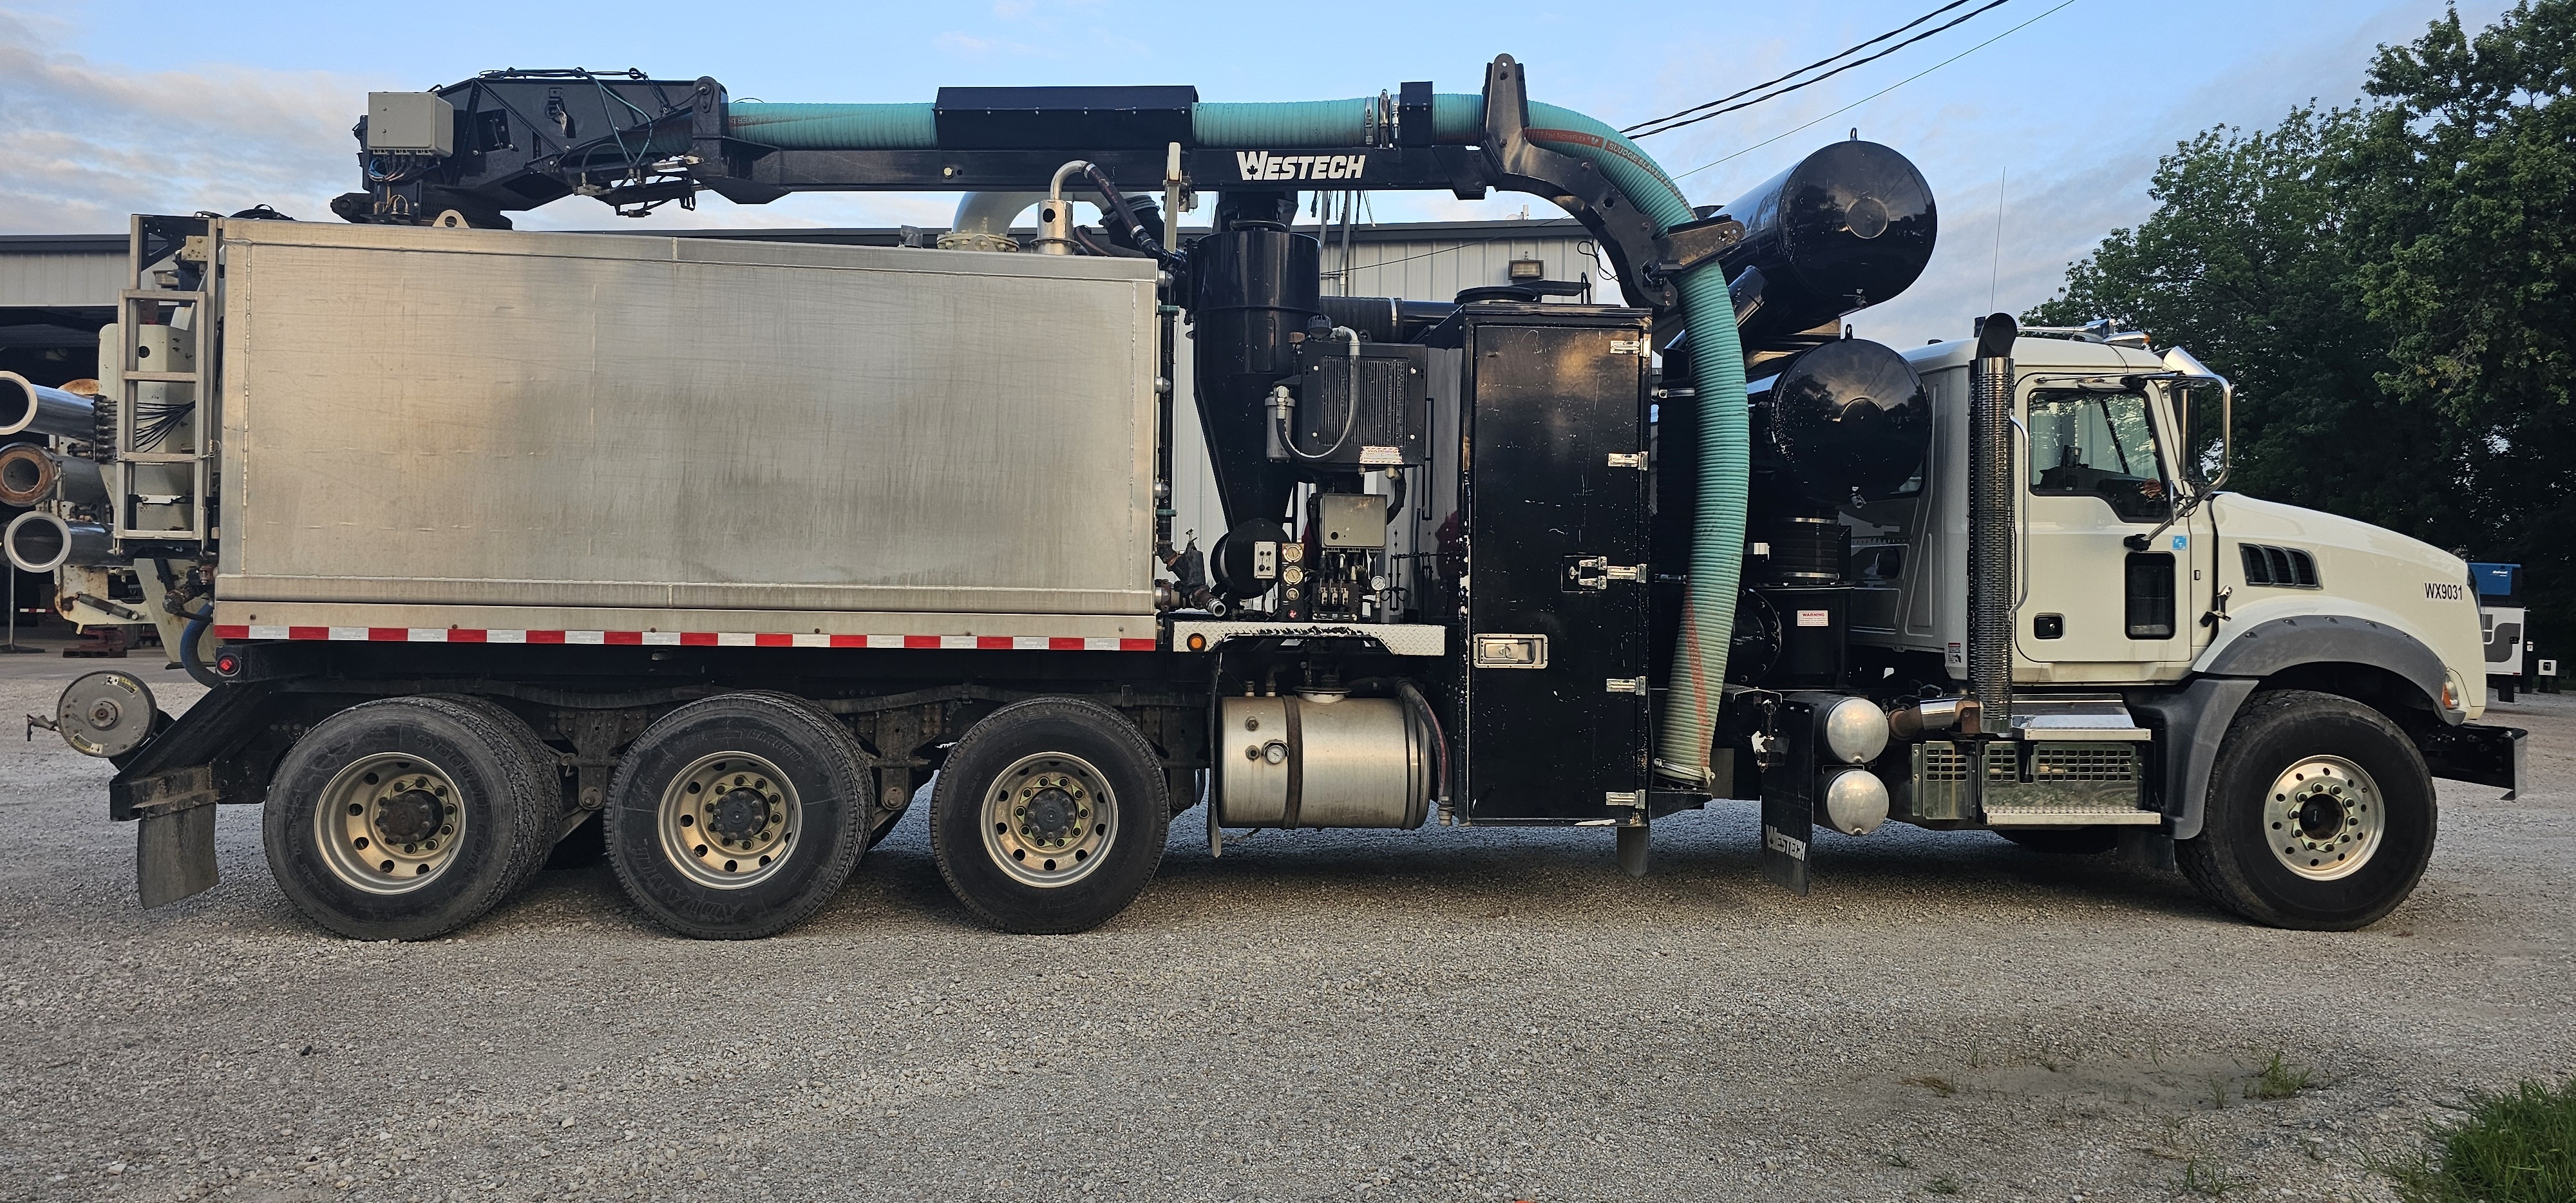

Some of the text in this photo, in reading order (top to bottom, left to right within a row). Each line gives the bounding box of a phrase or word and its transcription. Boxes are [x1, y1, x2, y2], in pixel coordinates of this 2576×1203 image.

[1236, 151, 1366, 180] WESTECH
[1609, 143, 1638, 162] SLUDGE
[1638, 159, 1664, 181] SLAYER
[1665, 180, 1672, 188] by
[2425, 583, 2462, 600] WX9031
[1765, 824, 1806, 862] WESTECH
[632, 846, 744, 918] ADVANCE
